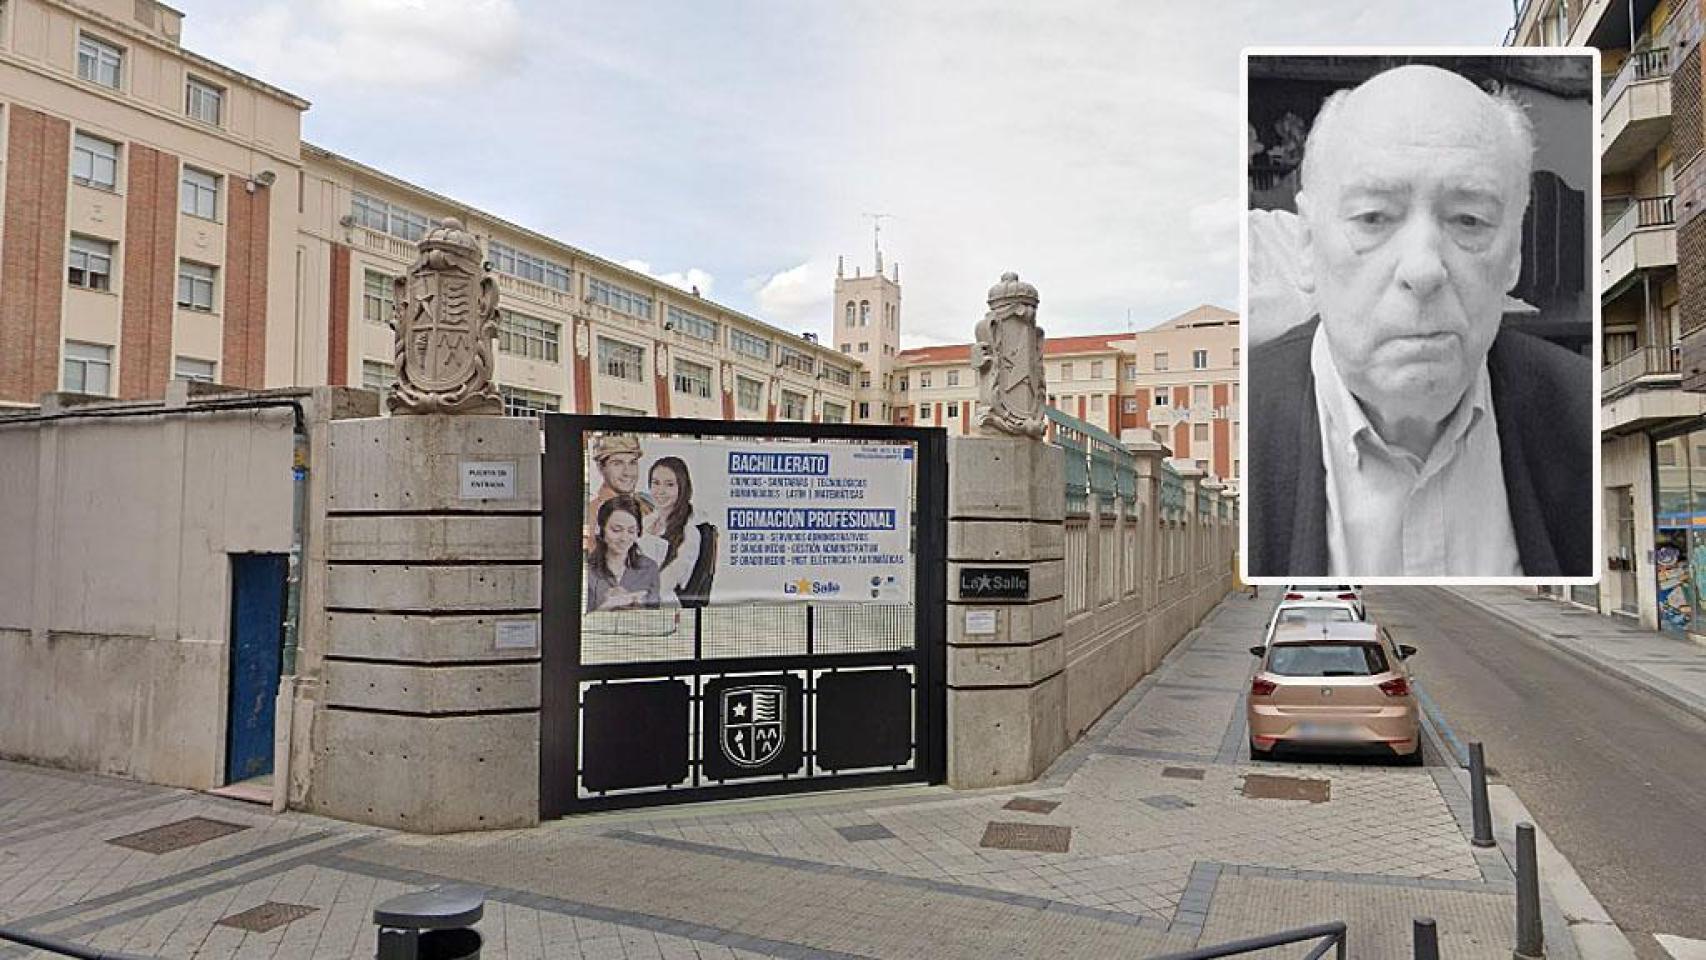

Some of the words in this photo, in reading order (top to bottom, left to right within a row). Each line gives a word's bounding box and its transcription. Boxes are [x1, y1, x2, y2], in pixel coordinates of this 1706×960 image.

[731, 454, 826, 474] BACHILLERATO
[731, 507, 804, 528] FORMACIÓN
[807, 510, 894, 529] PROFESIONAL
[784, 581, 797, 594] La
[812, 581, 841, 595] Salle
[993, 576, 1027, 590] Salle
